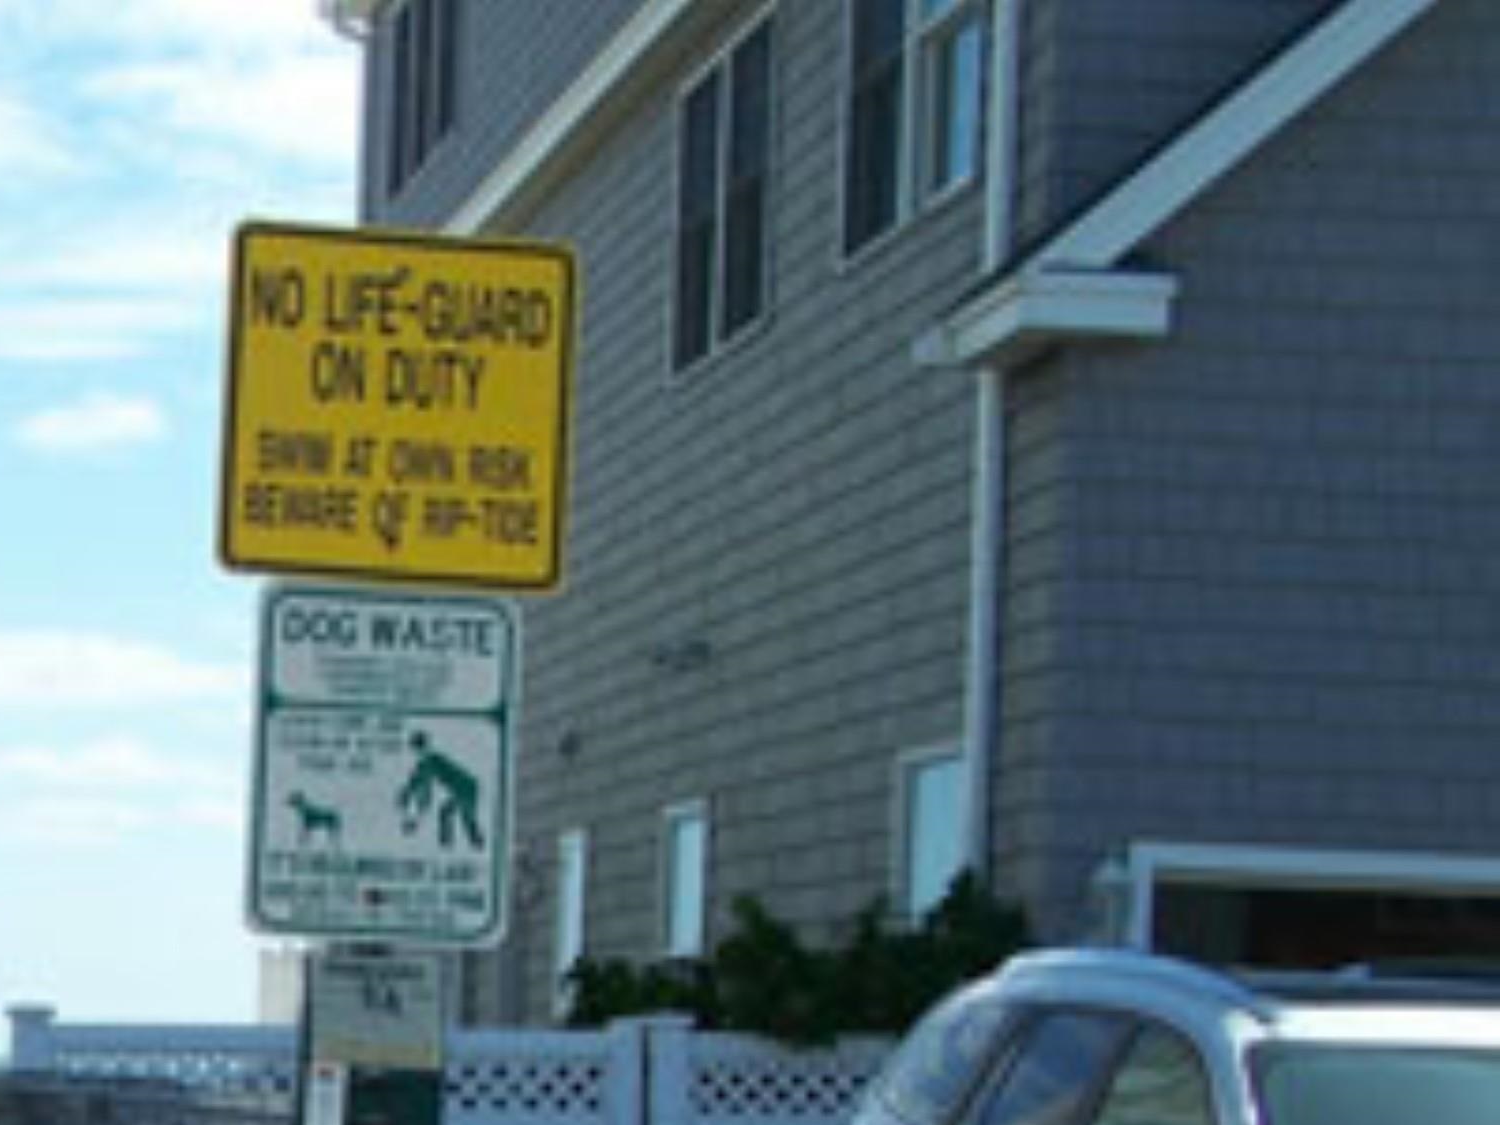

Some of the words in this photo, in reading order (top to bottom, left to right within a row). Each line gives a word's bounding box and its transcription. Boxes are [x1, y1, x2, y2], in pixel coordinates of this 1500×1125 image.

[251, 266, 304, 329] NO
[323, 267, 550, 348] LIFE-GUARD
[311, 341, 366, 404] ON
[385, 347, 484, 409] DUTY
[343, 437, 379, 478] AT
[245, 481, 357, 534] BEWARE
[283, 608, 357, 648] DOG
[371, 615, 495, 657] WASTE
